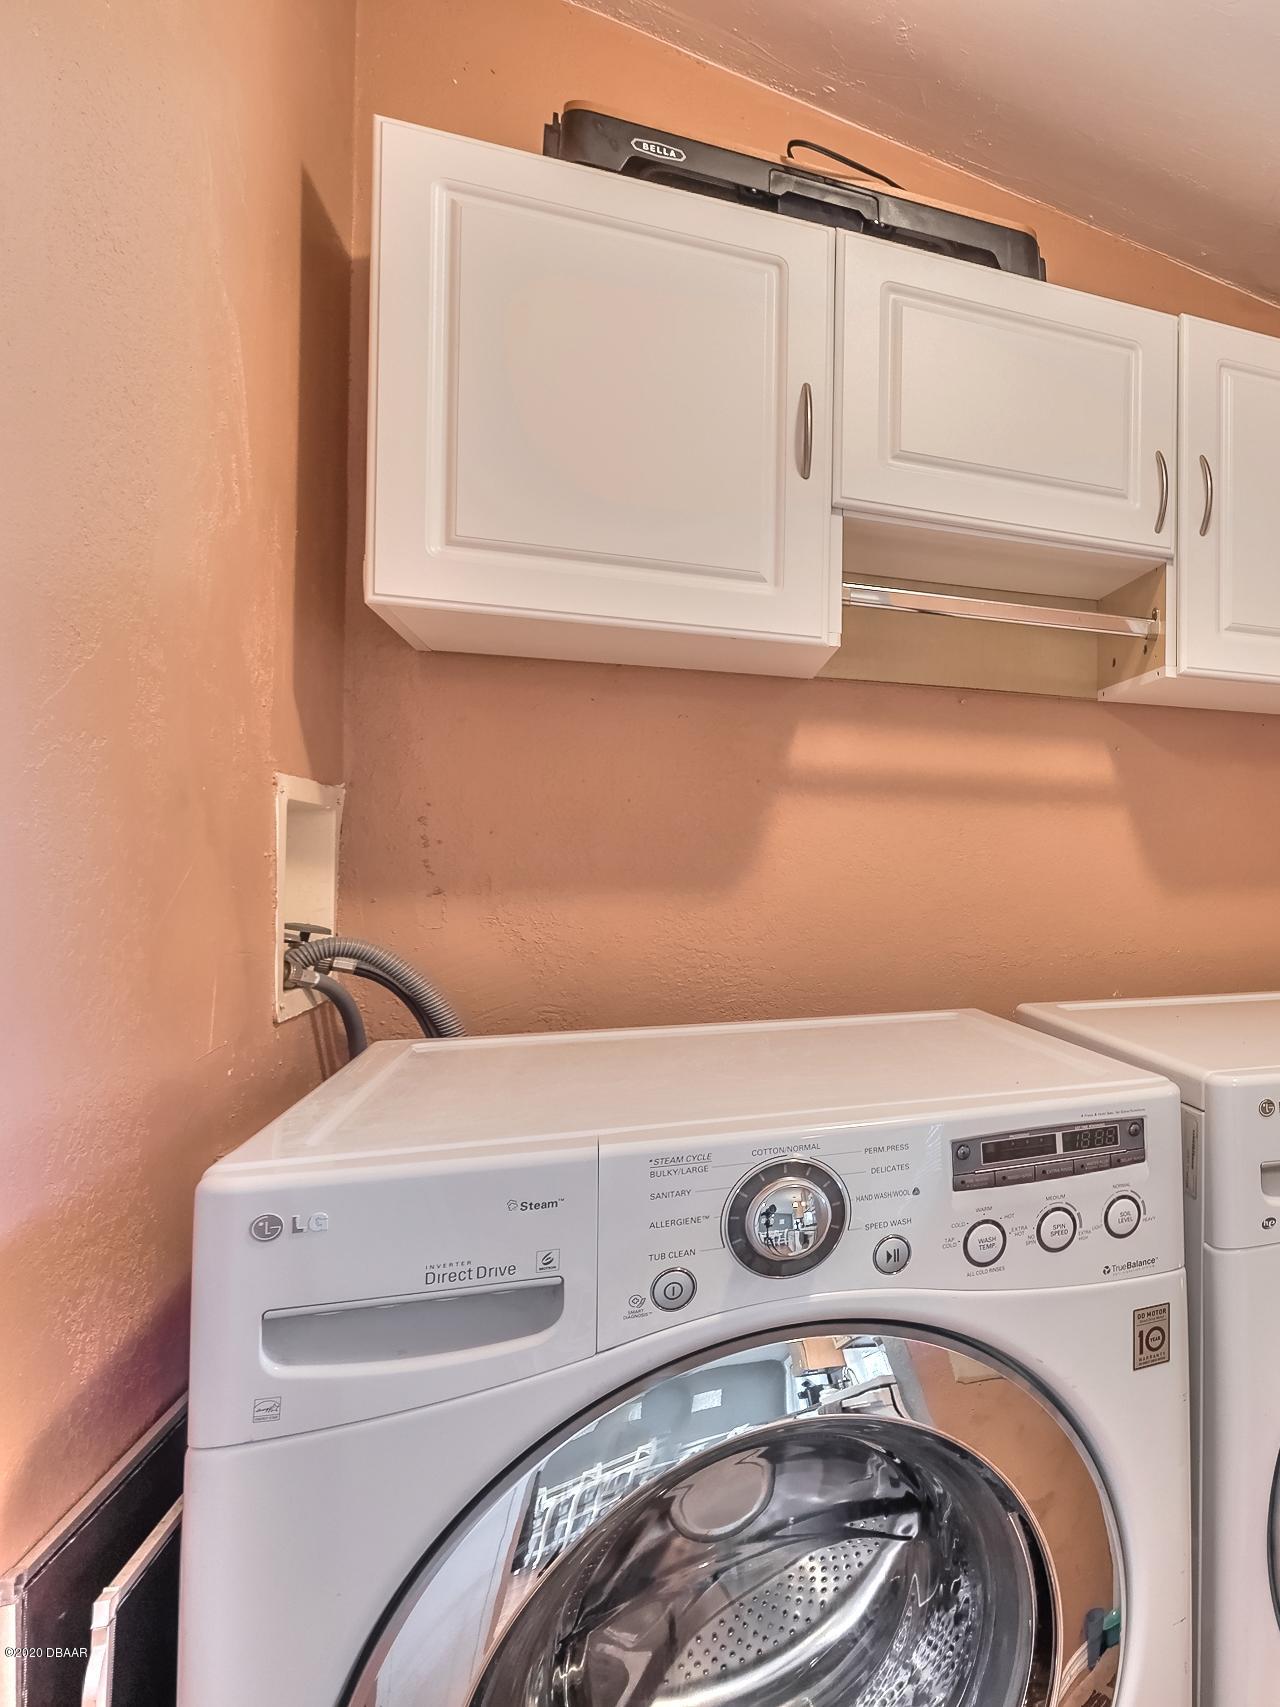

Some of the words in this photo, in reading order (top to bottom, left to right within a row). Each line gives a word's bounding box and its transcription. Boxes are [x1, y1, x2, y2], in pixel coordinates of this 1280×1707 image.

[642, 142, 676, 158] BELLA
[752, 1144, 821, 1156] COTTON/NORMAL
[686, 1152, 712, 1162] CYCLE
[650, 1165, 709, 1178] BULKY/LARGE
[870, 1163, 910, 1174] DELICATES
[650, 1190, 692, 1200] SANITARY
[856, 1194, 873, 1202] HAND
[292, 1212, 328, 1234] LG
[864, 1221, 888, 1231] SPEED
[890, 1218, 912, 1226] WASH
[648, 1252, 666, 1262] TUB
[668, 1248, 696, 1260] CLEAN
[425, 1260, 472, 1270] INVERTER
[425, 1268, 474, 1285] Direct
[476, 1264, 516, 1280] Drive
[1147, 1308, 1166, 1318] MOTOR
[1138, 1326, 1166, 1356] 10
